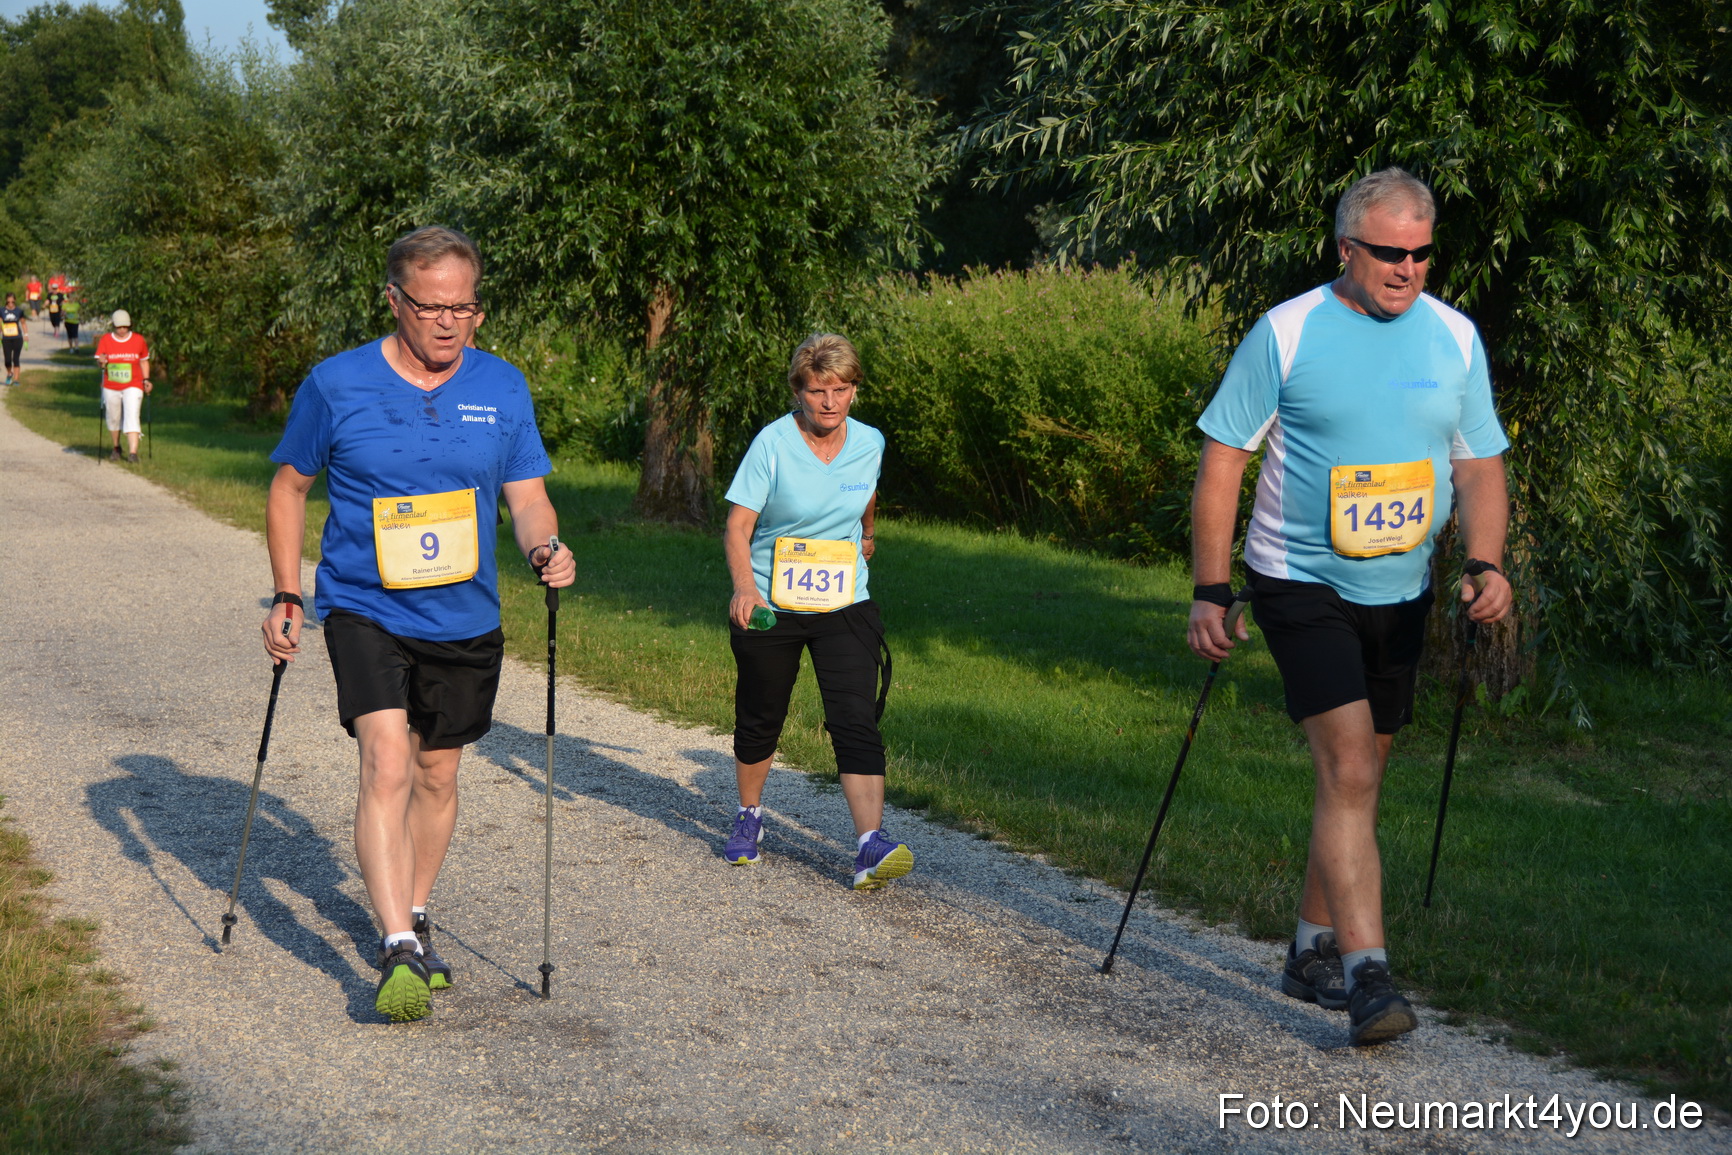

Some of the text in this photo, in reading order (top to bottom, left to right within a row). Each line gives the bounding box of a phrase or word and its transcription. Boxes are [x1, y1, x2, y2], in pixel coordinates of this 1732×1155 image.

[457, 403, 498, 413] Christian Lenz
[461, 414, 487, 423] Allianz
[1347, 479, 1386, 488] firmenlauf
[1337, 491, 1368, 499] walken
[390, 510, 428, 520] firmenlauf
[1344, 497, 1425, 532] 1434
[381, 522, 411, 531] walken
[420, 532, 440, 560] 9
[782, 567, 845, 593] 1431
